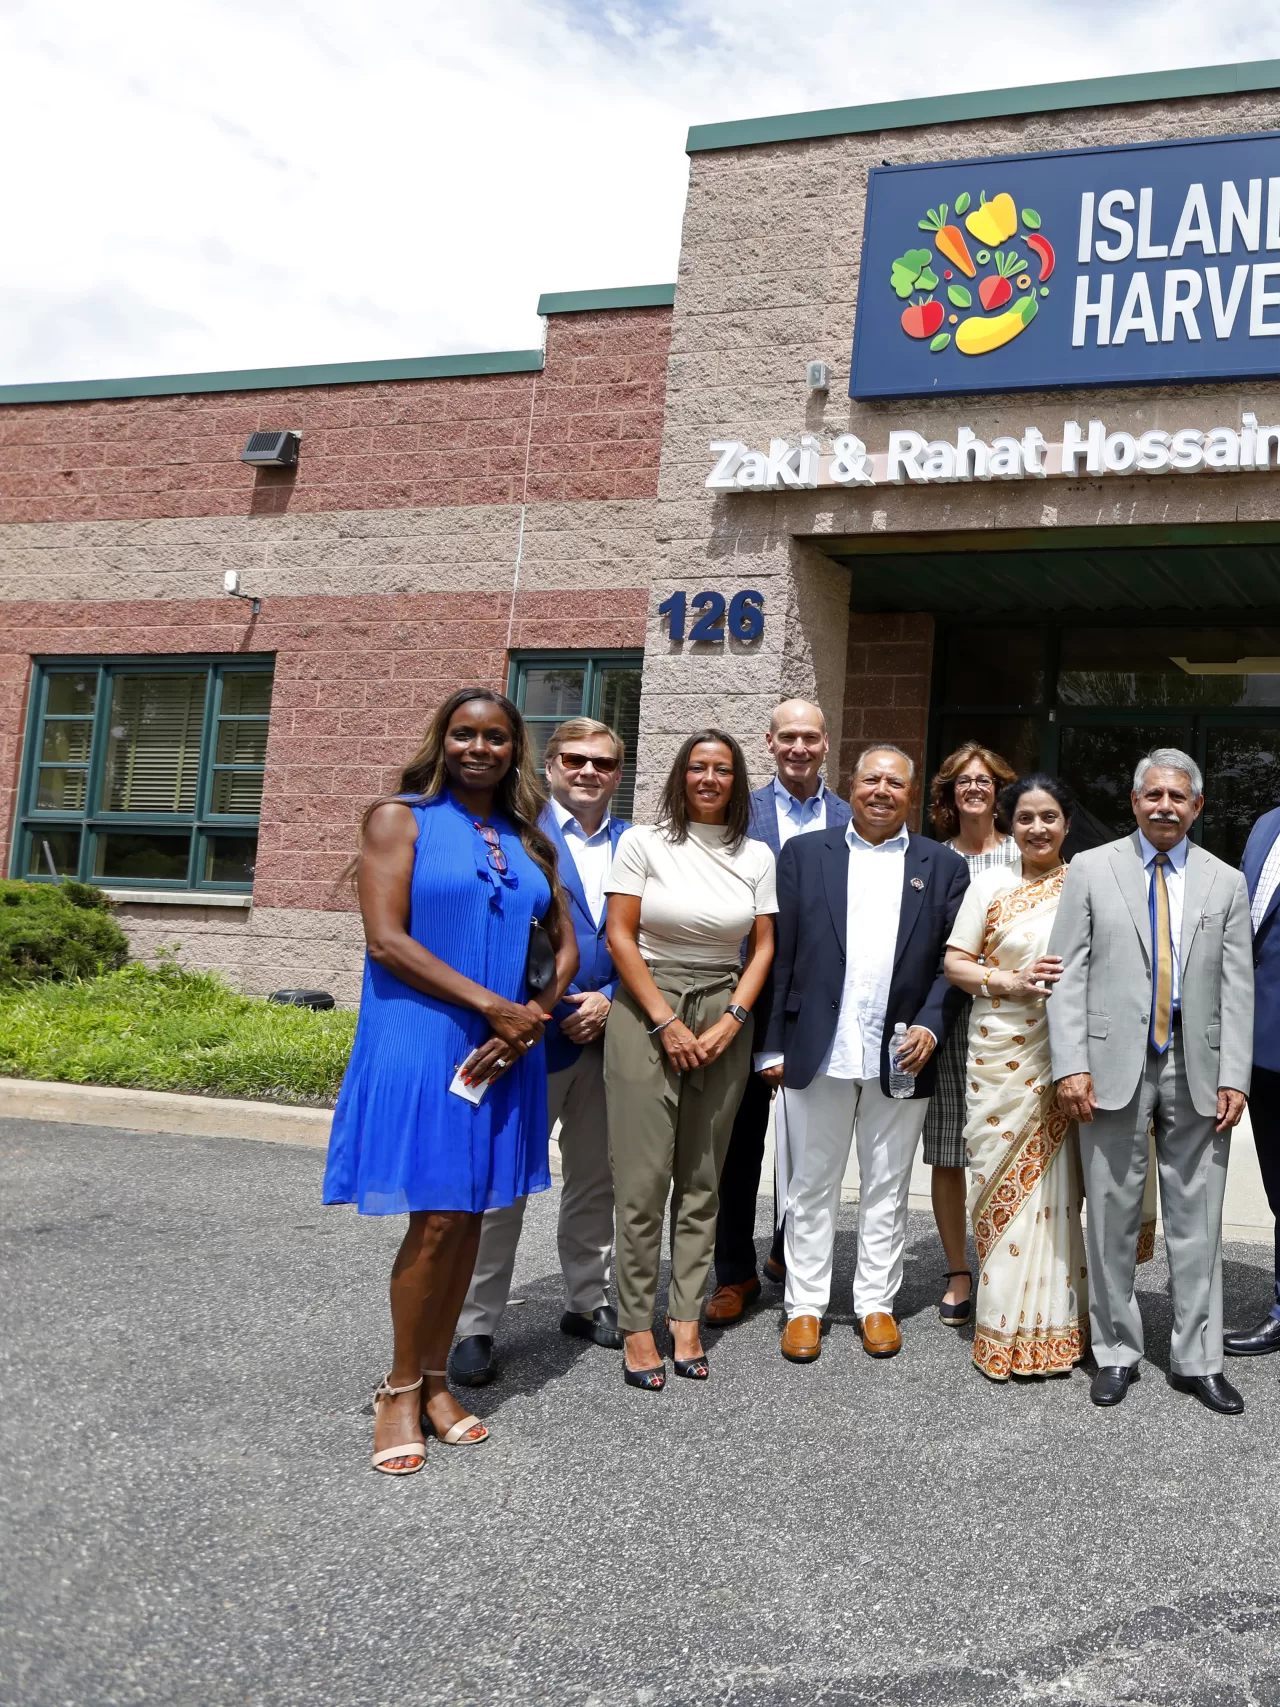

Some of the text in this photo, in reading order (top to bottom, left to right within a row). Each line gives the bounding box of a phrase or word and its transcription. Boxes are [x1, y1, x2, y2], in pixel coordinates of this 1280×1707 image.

[705, 436, 820, 491] Zaki
[829, 433, 875, 486] &
[888, 427, 1046, 484] Rahat
[658, 589, 765, 640] 126
